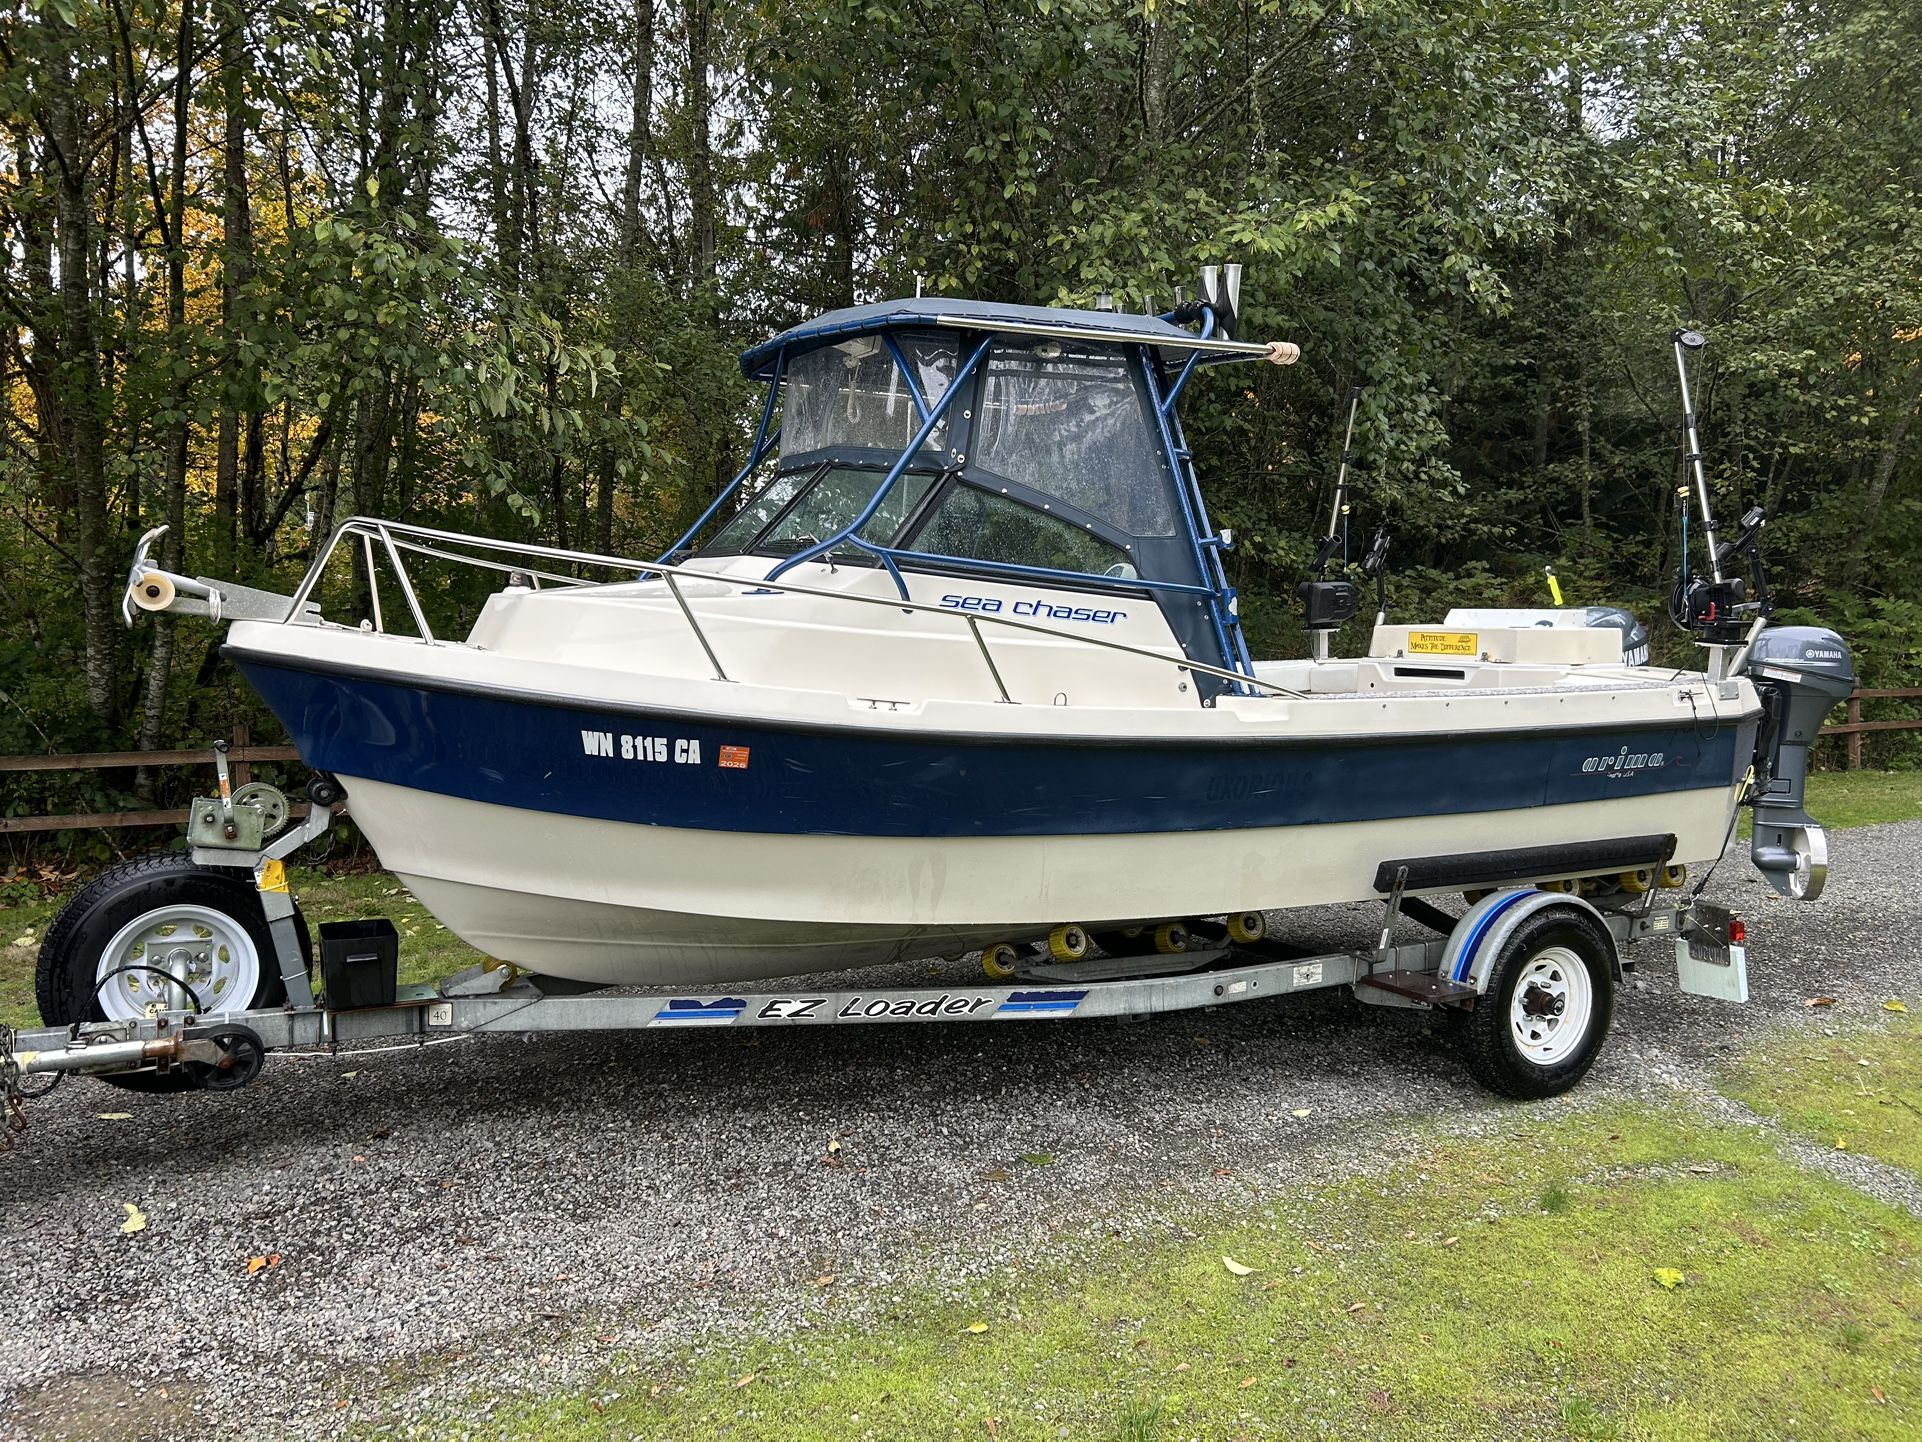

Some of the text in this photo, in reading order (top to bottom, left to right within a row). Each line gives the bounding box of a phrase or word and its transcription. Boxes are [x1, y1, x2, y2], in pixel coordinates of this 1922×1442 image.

[939, 594, 1128, 625] sea chaser
[1815, 650, 1842, 659] YAMAHA
[581, 730, 614, 758] WN
[620, 734, 668, 762] 8115
[674, 738, 701, 764] CA
[720, 760, 747, 769] 2026
[433, 1010, 448, 1021] 40
[756, 993, 994, 1020] EZ Loader
